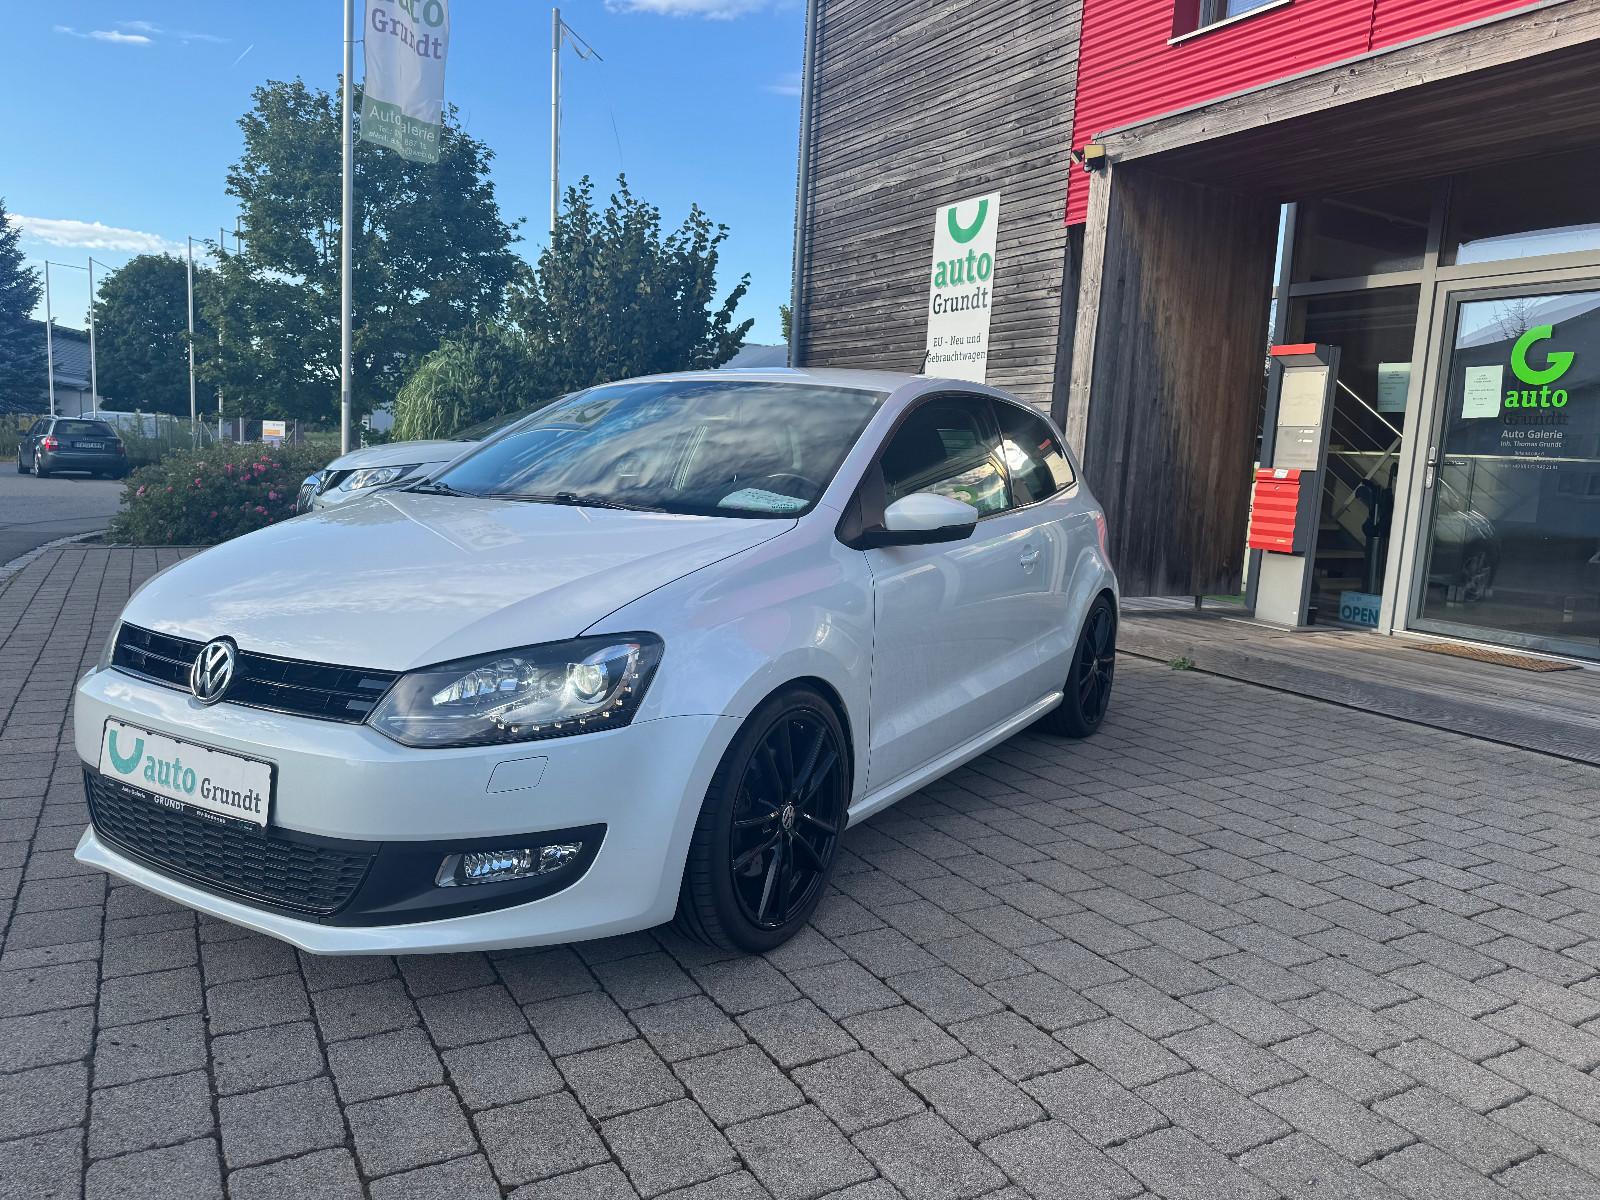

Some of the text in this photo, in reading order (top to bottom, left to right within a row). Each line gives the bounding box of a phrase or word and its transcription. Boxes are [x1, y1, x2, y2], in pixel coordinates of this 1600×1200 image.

[371, 7, 443, 60] Grundt
[934, 248, 993, 288] auto
[932, 286, 989, 315] Grundt
[933, 336, 943, 347] EU
[950, 335, 964, 346] Neu
[966, 332, 981, 344] und
[927, 351, 986, 363] Gebrauchtwagen
[1504, 385, 1568, 408] auto
[1501, 430, 1563, 439] Auto Galerie
[1341, 604, 1379, 625] OPEN
[143, 754, 262, 814] auto Grundt
[153, 794, 187, 812] GRUNDT
